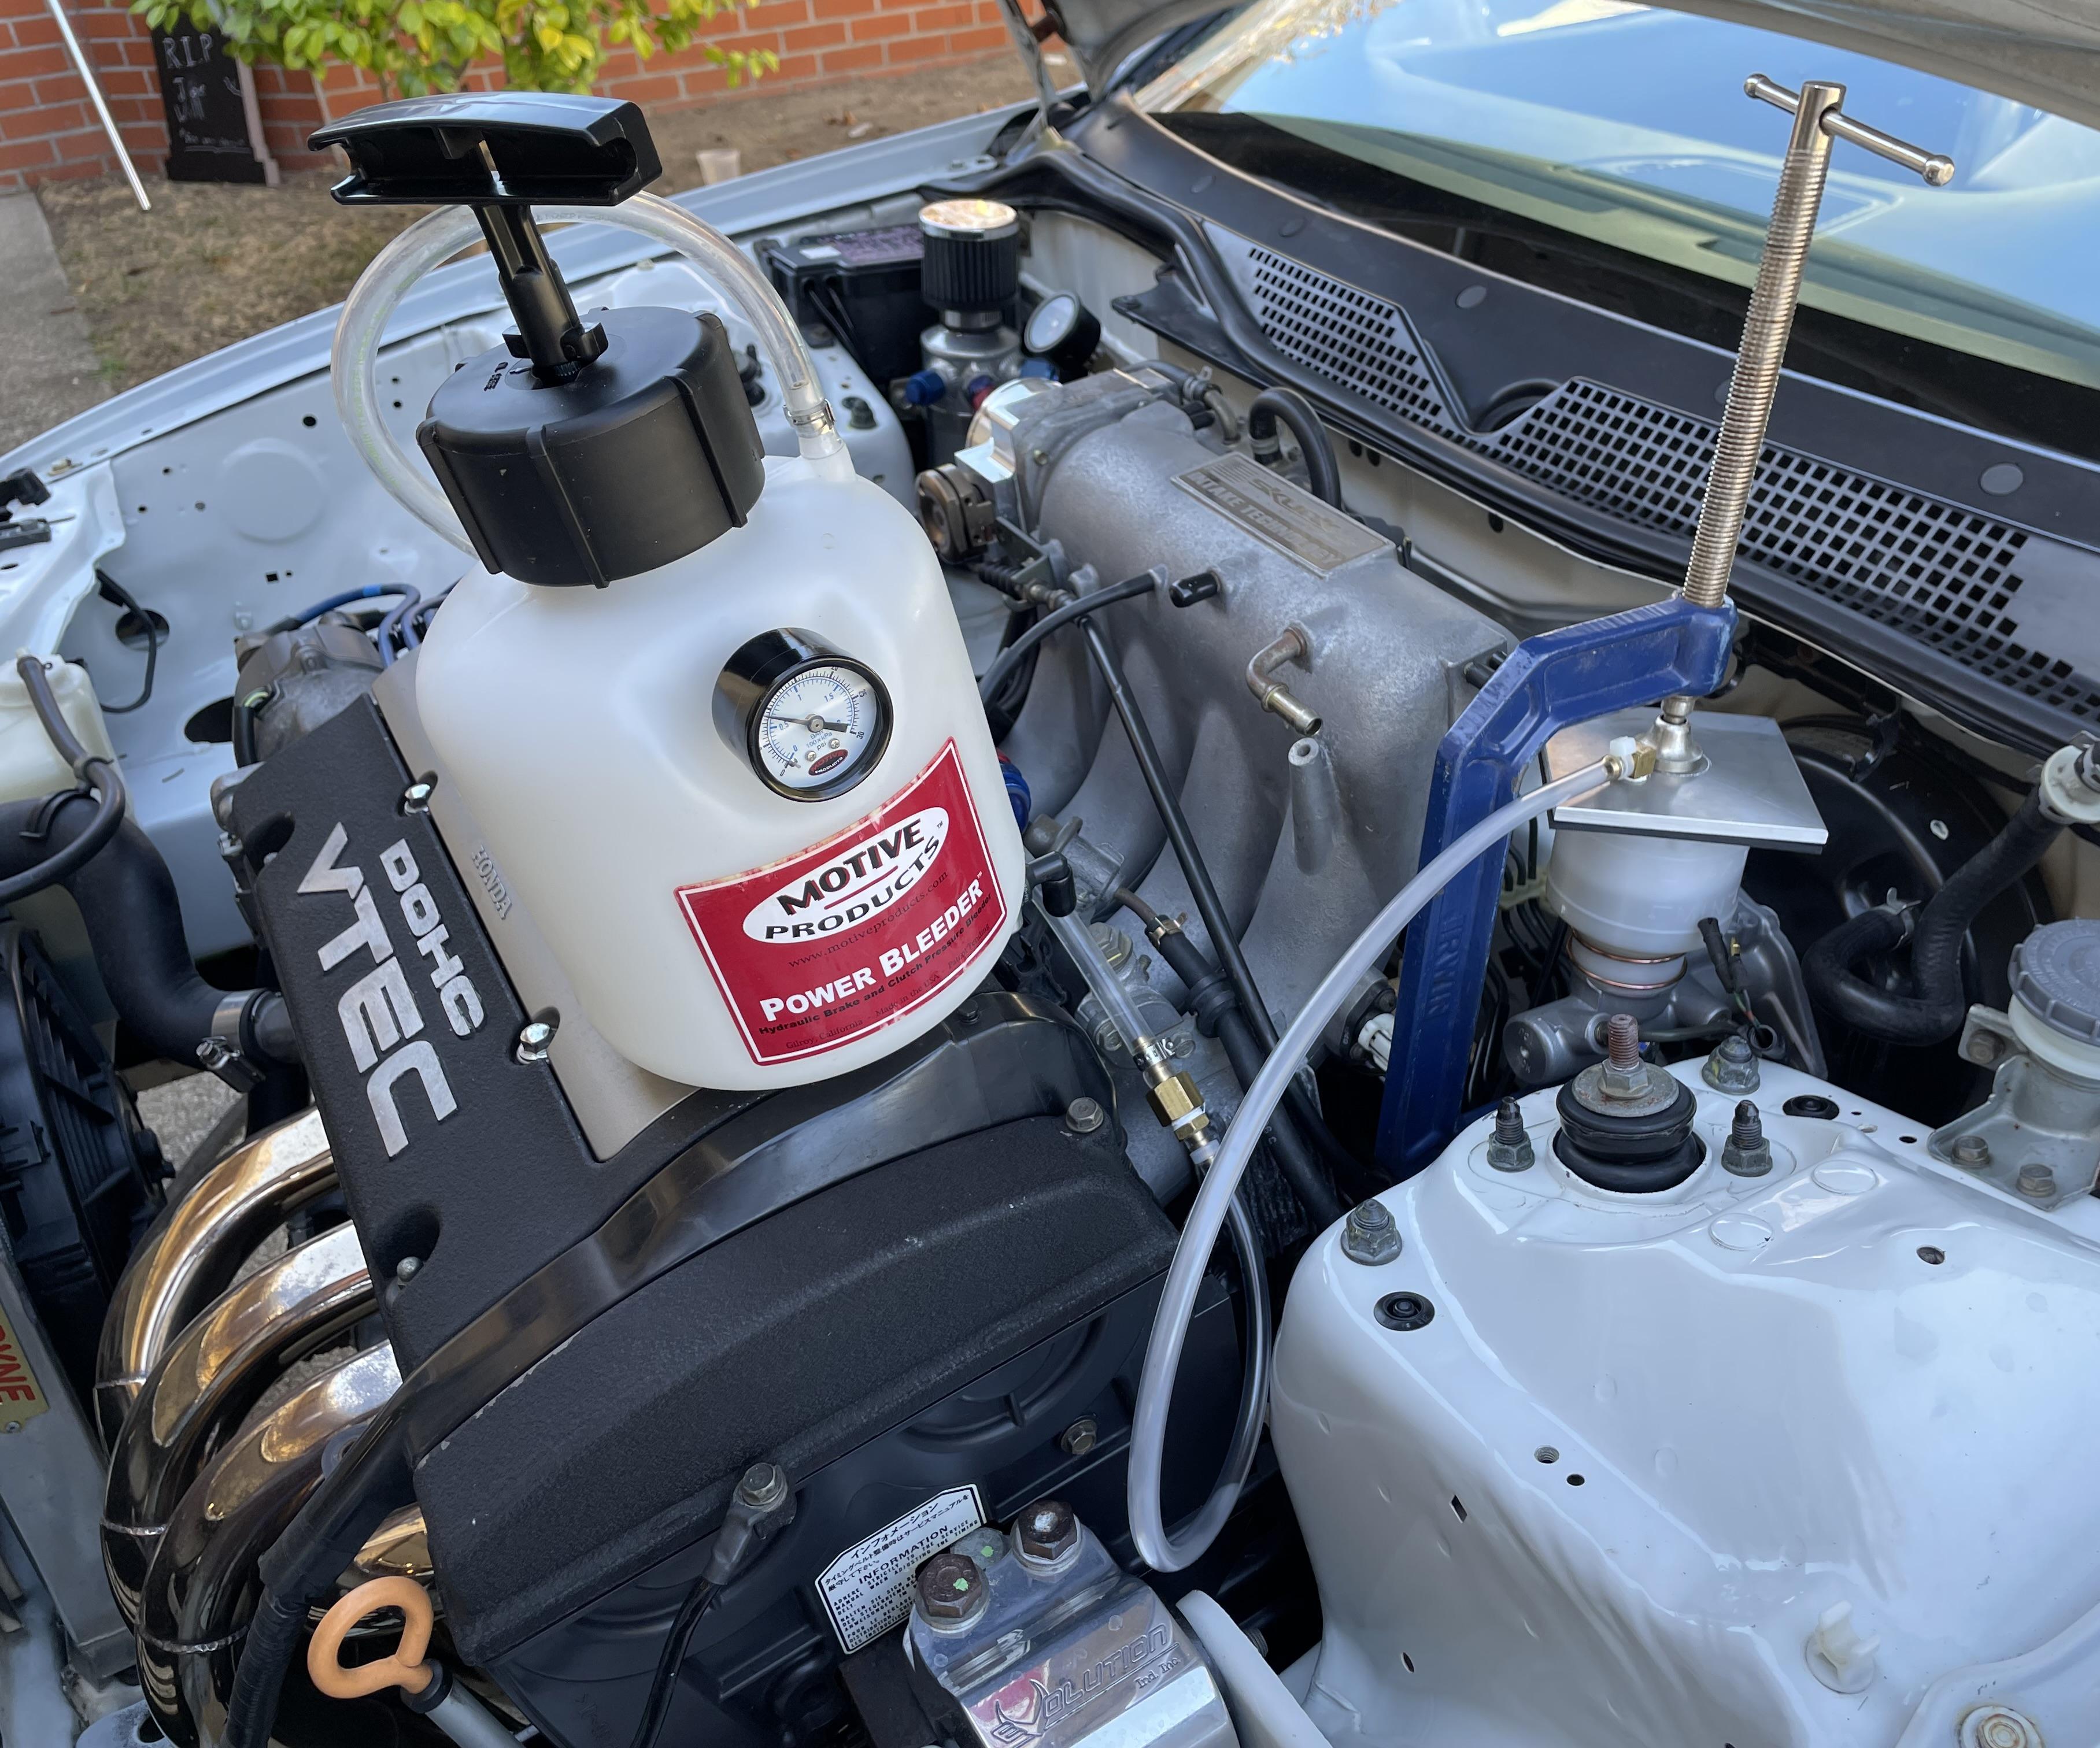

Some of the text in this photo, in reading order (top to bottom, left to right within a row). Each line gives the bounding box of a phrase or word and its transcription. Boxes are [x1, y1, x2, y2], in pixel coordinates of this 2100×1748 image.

[1186, 471, 1343, 564] INTAKE TECHNOLOGY
[779, 721, 789, 731] 0.5
[815, 756, 844, 774] PRODUCTS
[816, 742, 827, 750] psi
[856, 731, 864, 739] 30
[471, 845, 513, 920] HONDA
[765, 835, 940, 940] PRODUCTS
[777, 817, 926, 917] MOTIVE
[379, 838, 485, 1036] DOHC
[759, 967, 877, 1022] POWER
[879, 878, 984, 977] BLEEDER
[788, 870, 948, 968] www.motiveproducts.com
[297, 822, 457, 1157] VTEC
[759, 892, 992, 1034] Hydraulic Brake and Clutch Pressure Bleeder
[786, 1036, 818, 1049] Gilroy,
[819, 1020, 863, 1040] California
[875, 1001, 900, 1017] Made
[900, 995, 909, 1006] in
[909, 986, 923, 999] the
[924, 971, 941, 986] USA
[834, 1519, 970, 1606] ADHERE STRICTLY TO THE SERVICE
[835, 1520, 978, 1612] MANUAL WHEN ADJUSTING THE TIMING
[851, 1502, 939, 1560] インフォメーション
[858, 1525, 949, 1585] INFORMATION
[841, 1605, 866, 1623] HALTEN
[871, 1595, 882, 1605] SIE
[886, 1582, 903, 1595] SICH
[842, 1617, 856, 1628] DES
[845, 1599, 893, 1632] ANWEISUNGEN
[848, 1625, 865, 1639] POUR
[991, 1624, 1167, 1746] EVOLUTION
